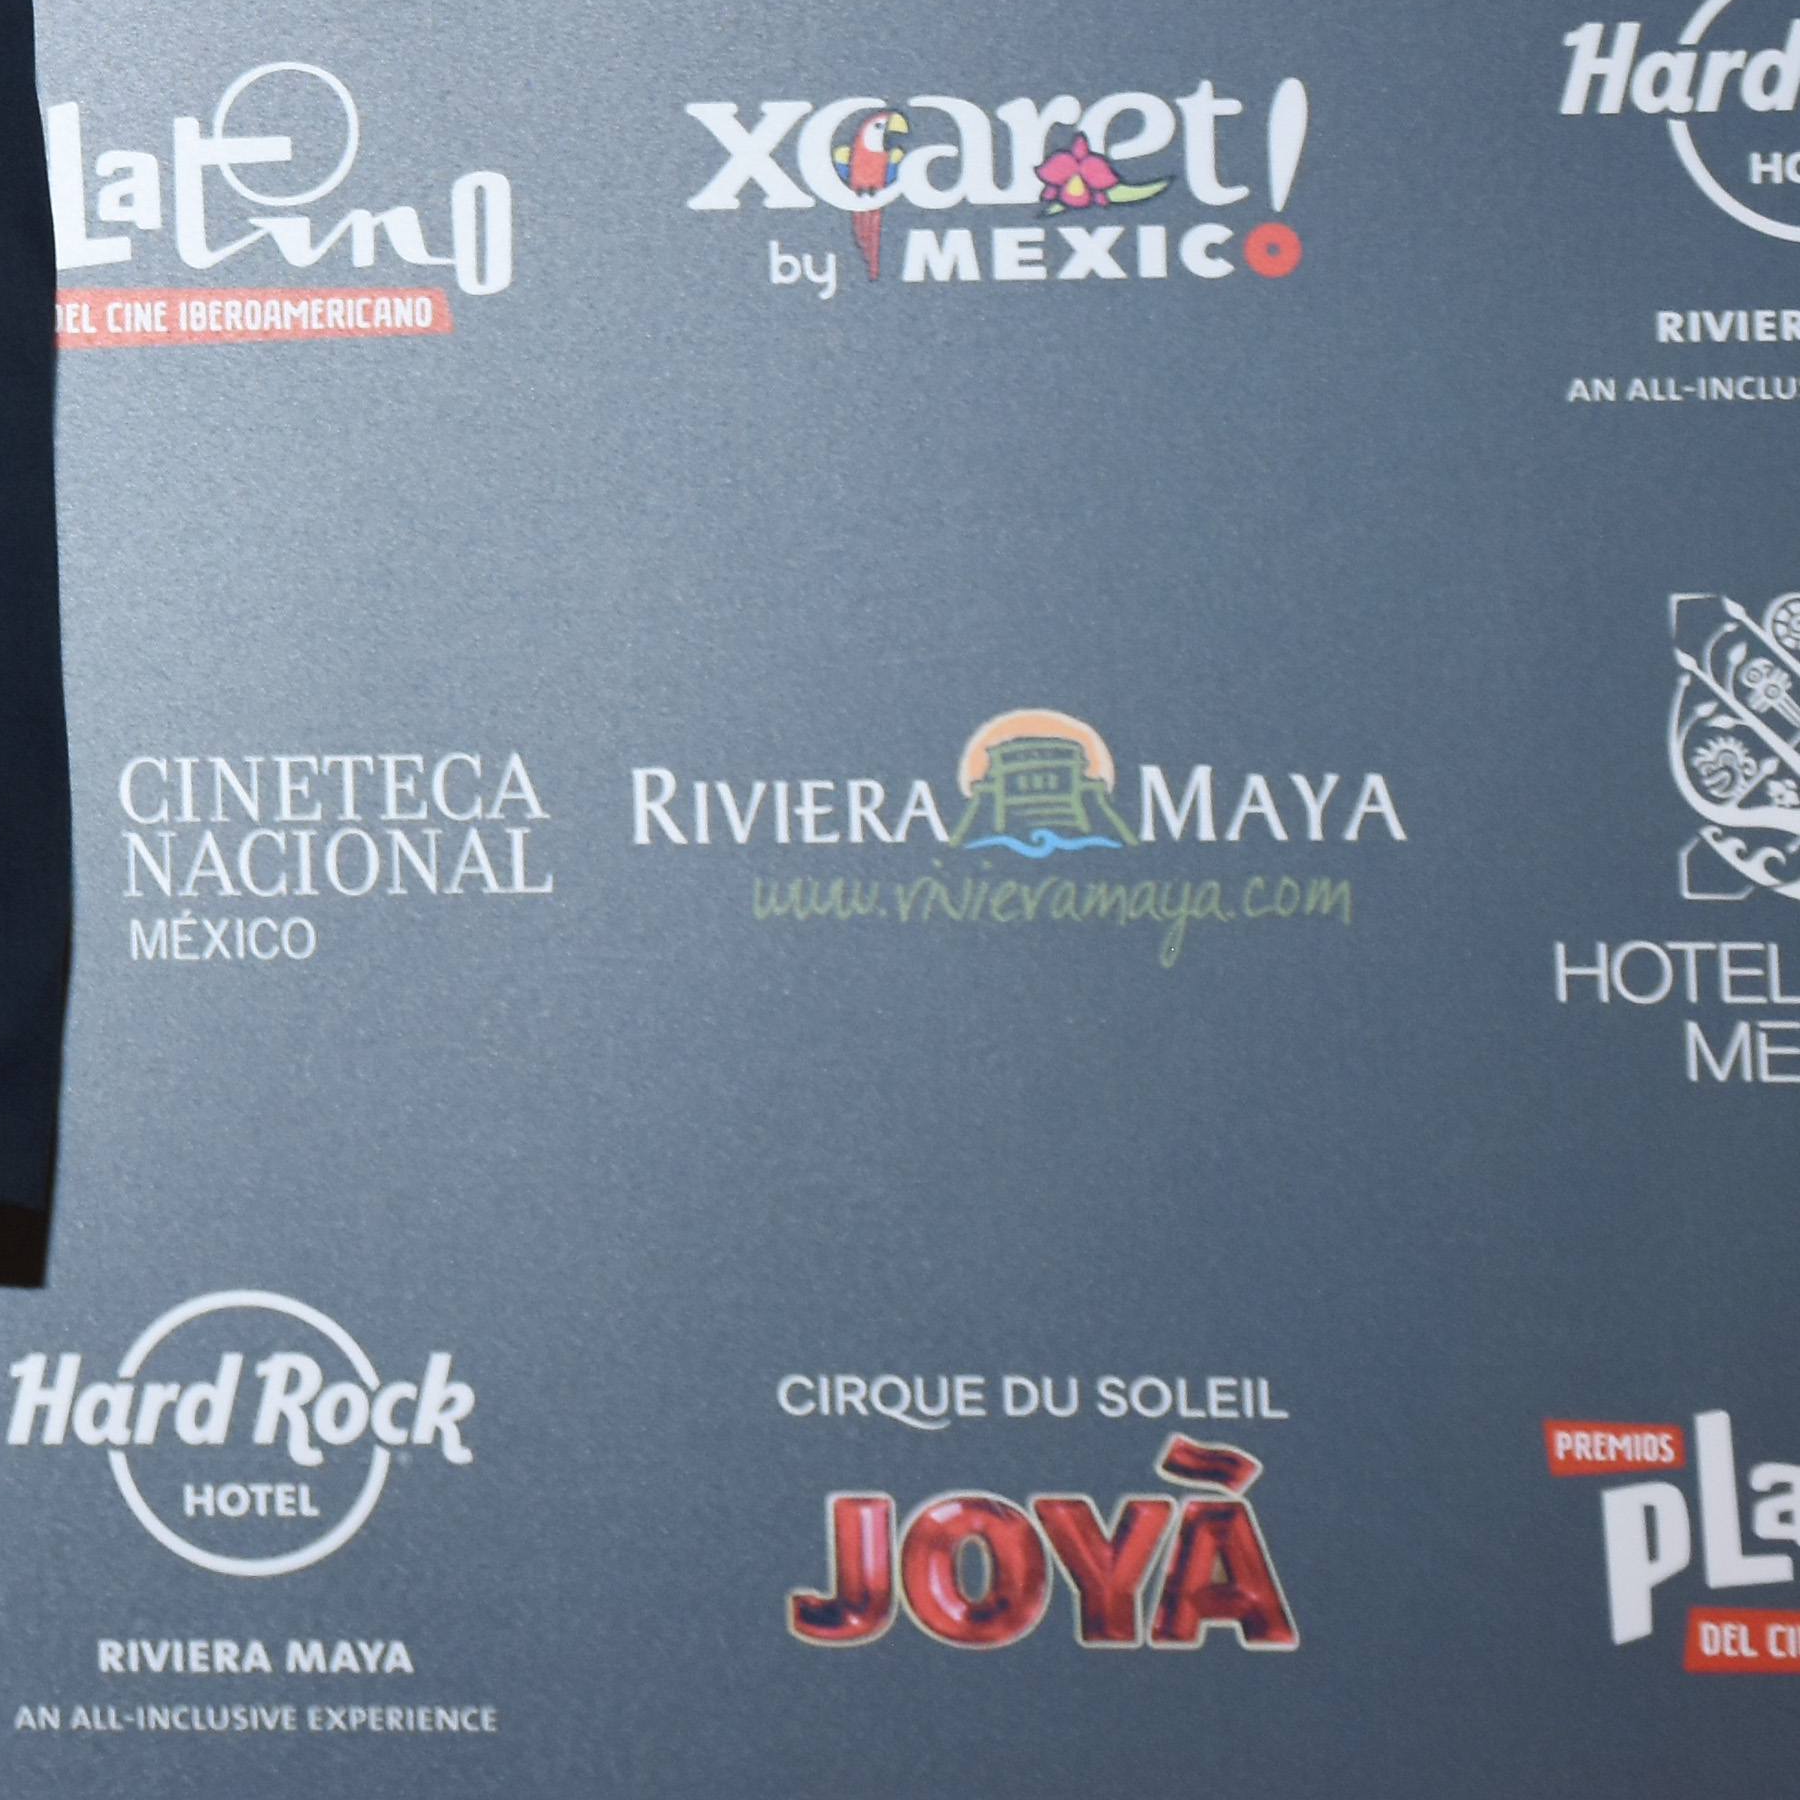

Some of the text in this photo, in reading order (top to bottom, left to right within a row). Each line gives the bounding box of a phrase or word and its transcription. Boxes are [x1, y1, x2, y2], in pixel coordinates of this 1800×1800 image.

[770, 220, 1301, 299] by MEXICO
[107, 301, 167, 332] CINE
[179, 297, 431, 331] IBEROAMERICANO
[1656, 310, 1800, 343] RIVIE
[1569, 375, 1800, 403] AN ALL-INCLU
[119, 753, 549, 824] CINETECA
[632, 765, 1406, 845] RIVIERA MAYA
[122, 828, 553, 897] NACIONAL
[130, 909, 316, 960] MÉXICO
[752, 859, 1353, 968] www.rivieramaya.com
[1555, 941, 1800, 1004] HOTEL
[8, 1353, 474, 1466] Hard Rock
[778, 1375, 1288, 1430] CIRQUE DU SOLEIL
[1555, 1432, 1674, 1462] PREMIOS
[185, 1484, 319, 1516] HOTEL
[99, 1641, 413, 1672] RIVIERA MAYA
[1700, 1622, 1757, 1657] DEL
[16, 1706, 495, 1731] AN ALL-INCLUSIVE EXPERIENCE
